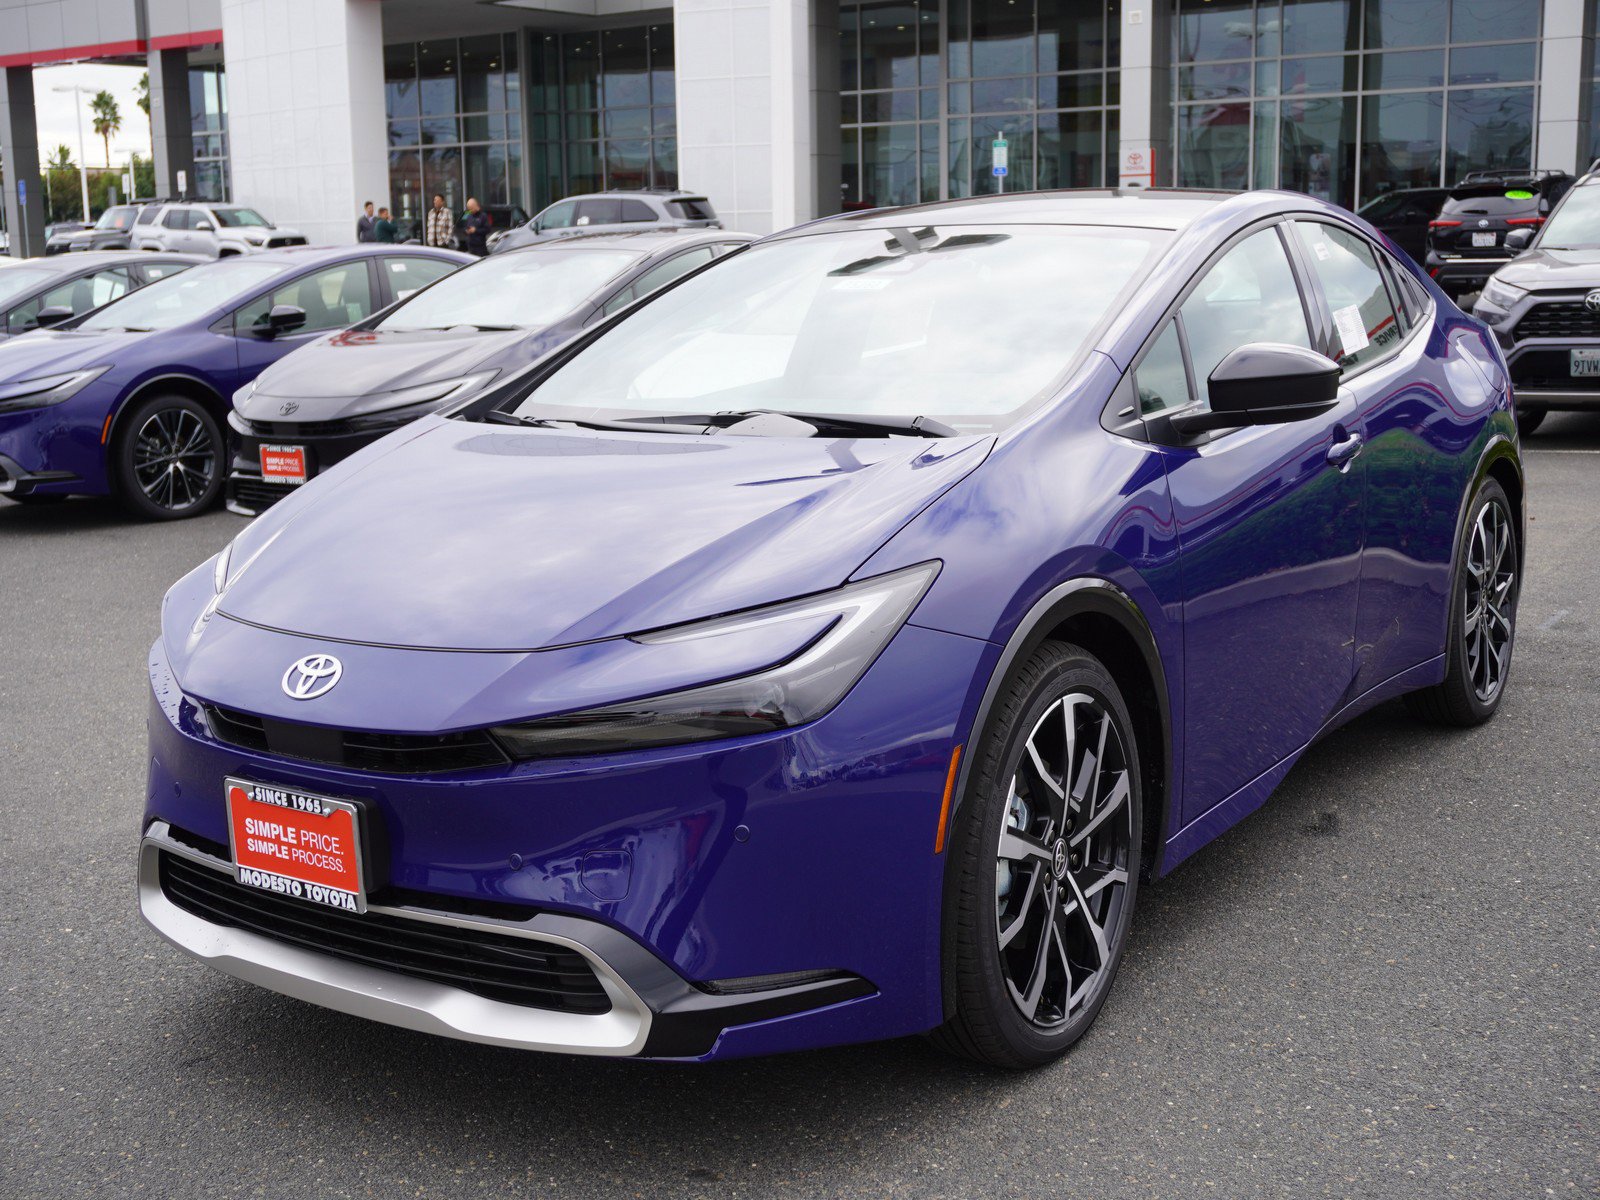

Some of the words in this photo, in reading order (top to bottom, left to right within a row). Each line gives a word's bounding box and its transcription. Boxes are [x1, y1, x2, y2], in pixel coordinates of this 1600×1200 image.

[1573, 359, 1600, 373] 9TVW
[254, 787, 288, 807] SINCE
[291, 795, 321, 813] 1965
[245, 817, 297, 844] SIMPLE
[300, 829, 344, 855] PRICE.
[247, 838, 289, 860] SIMPLE
[291, 848, 347, 873] PROCESS.
[240, 868, 302, 896] MODESTO
[304, 883, 357, 911] TOYOTA
